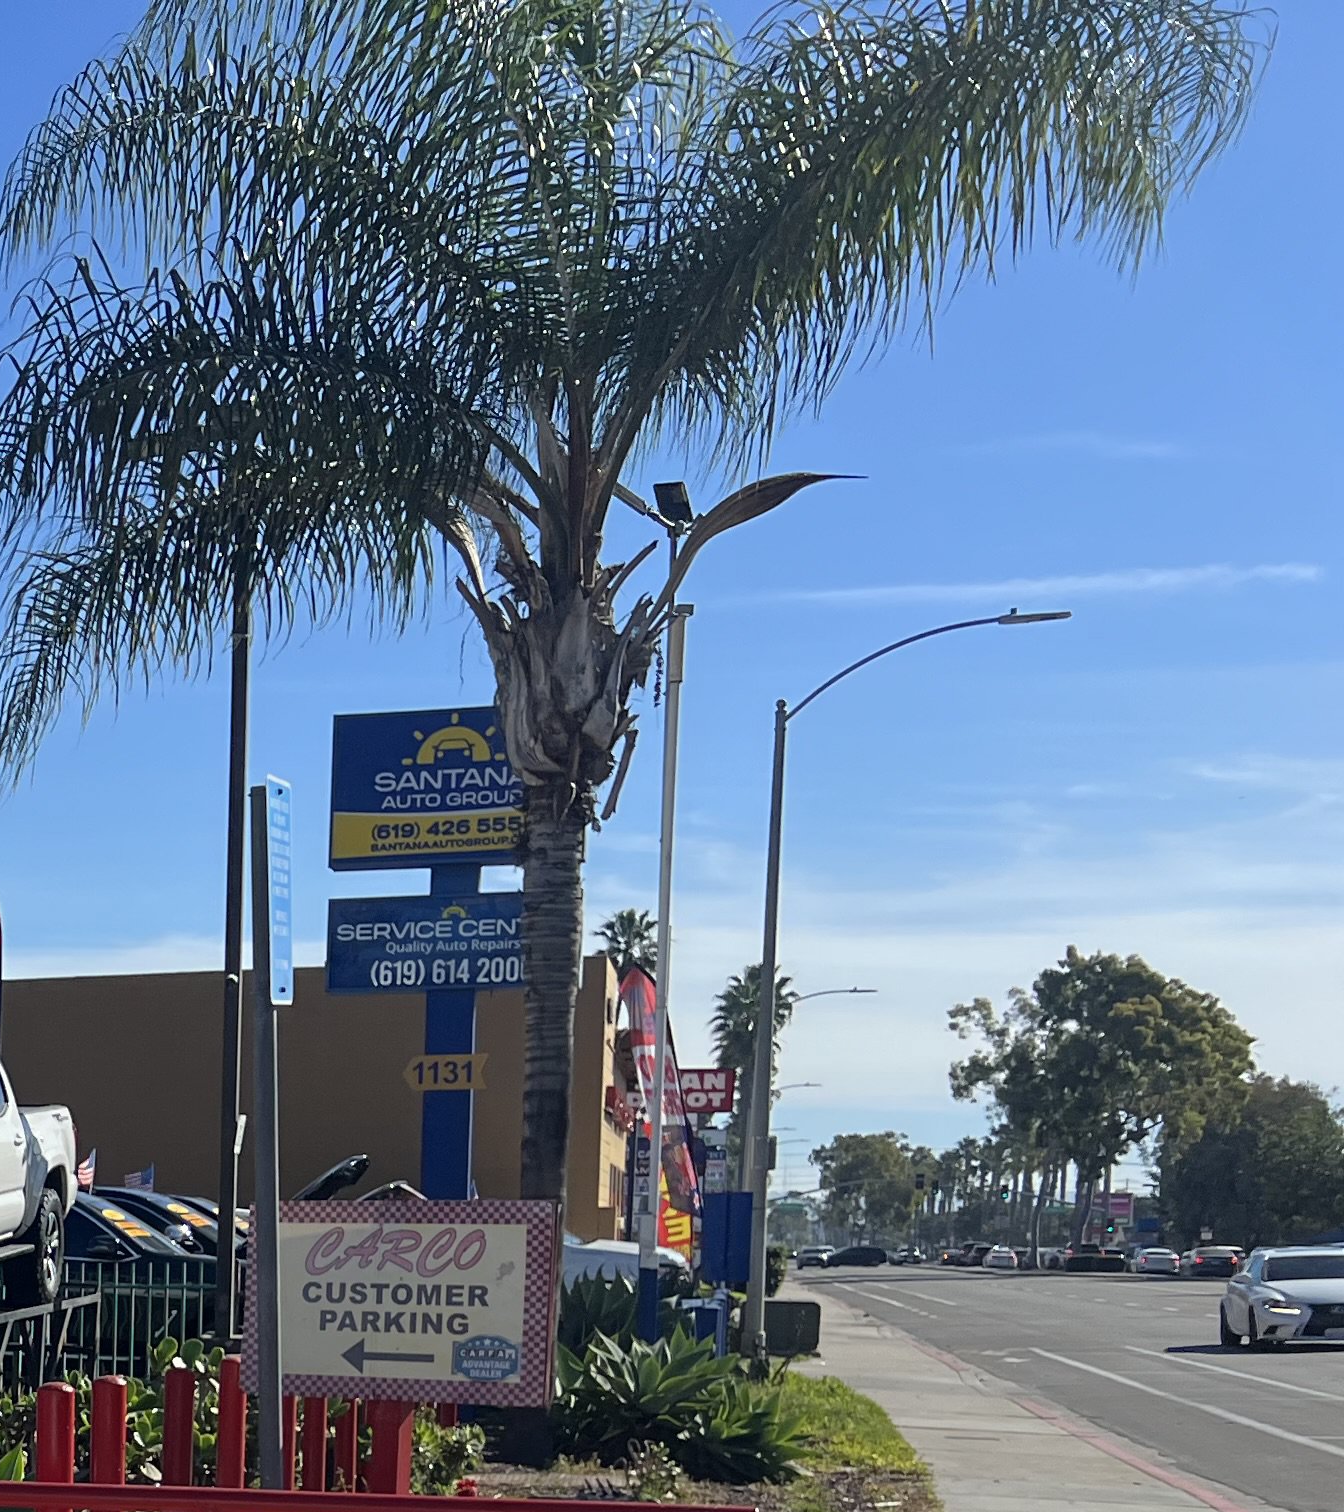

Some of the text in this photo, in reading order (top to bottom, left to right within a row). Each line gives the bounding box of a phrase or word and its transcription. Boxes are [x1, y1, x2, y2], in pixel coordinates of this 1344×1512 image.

[381, 793, 441, 810] AUTO
[371, 816, 522, 842] (619) 426 555
[336, 917, 522, 942] SERVICE CEN
[385, 938, 521, 955] Quality Auto Repairs
[370, 955, 525, 988] (619) 614 200
[413, 1061, 472, 1084] 1131
[305, 1226, 487, 1278] CARCO
[302, 1281, 489, 1307] CUSTOMER
[319, 1310, 470, 1335] PARKING
